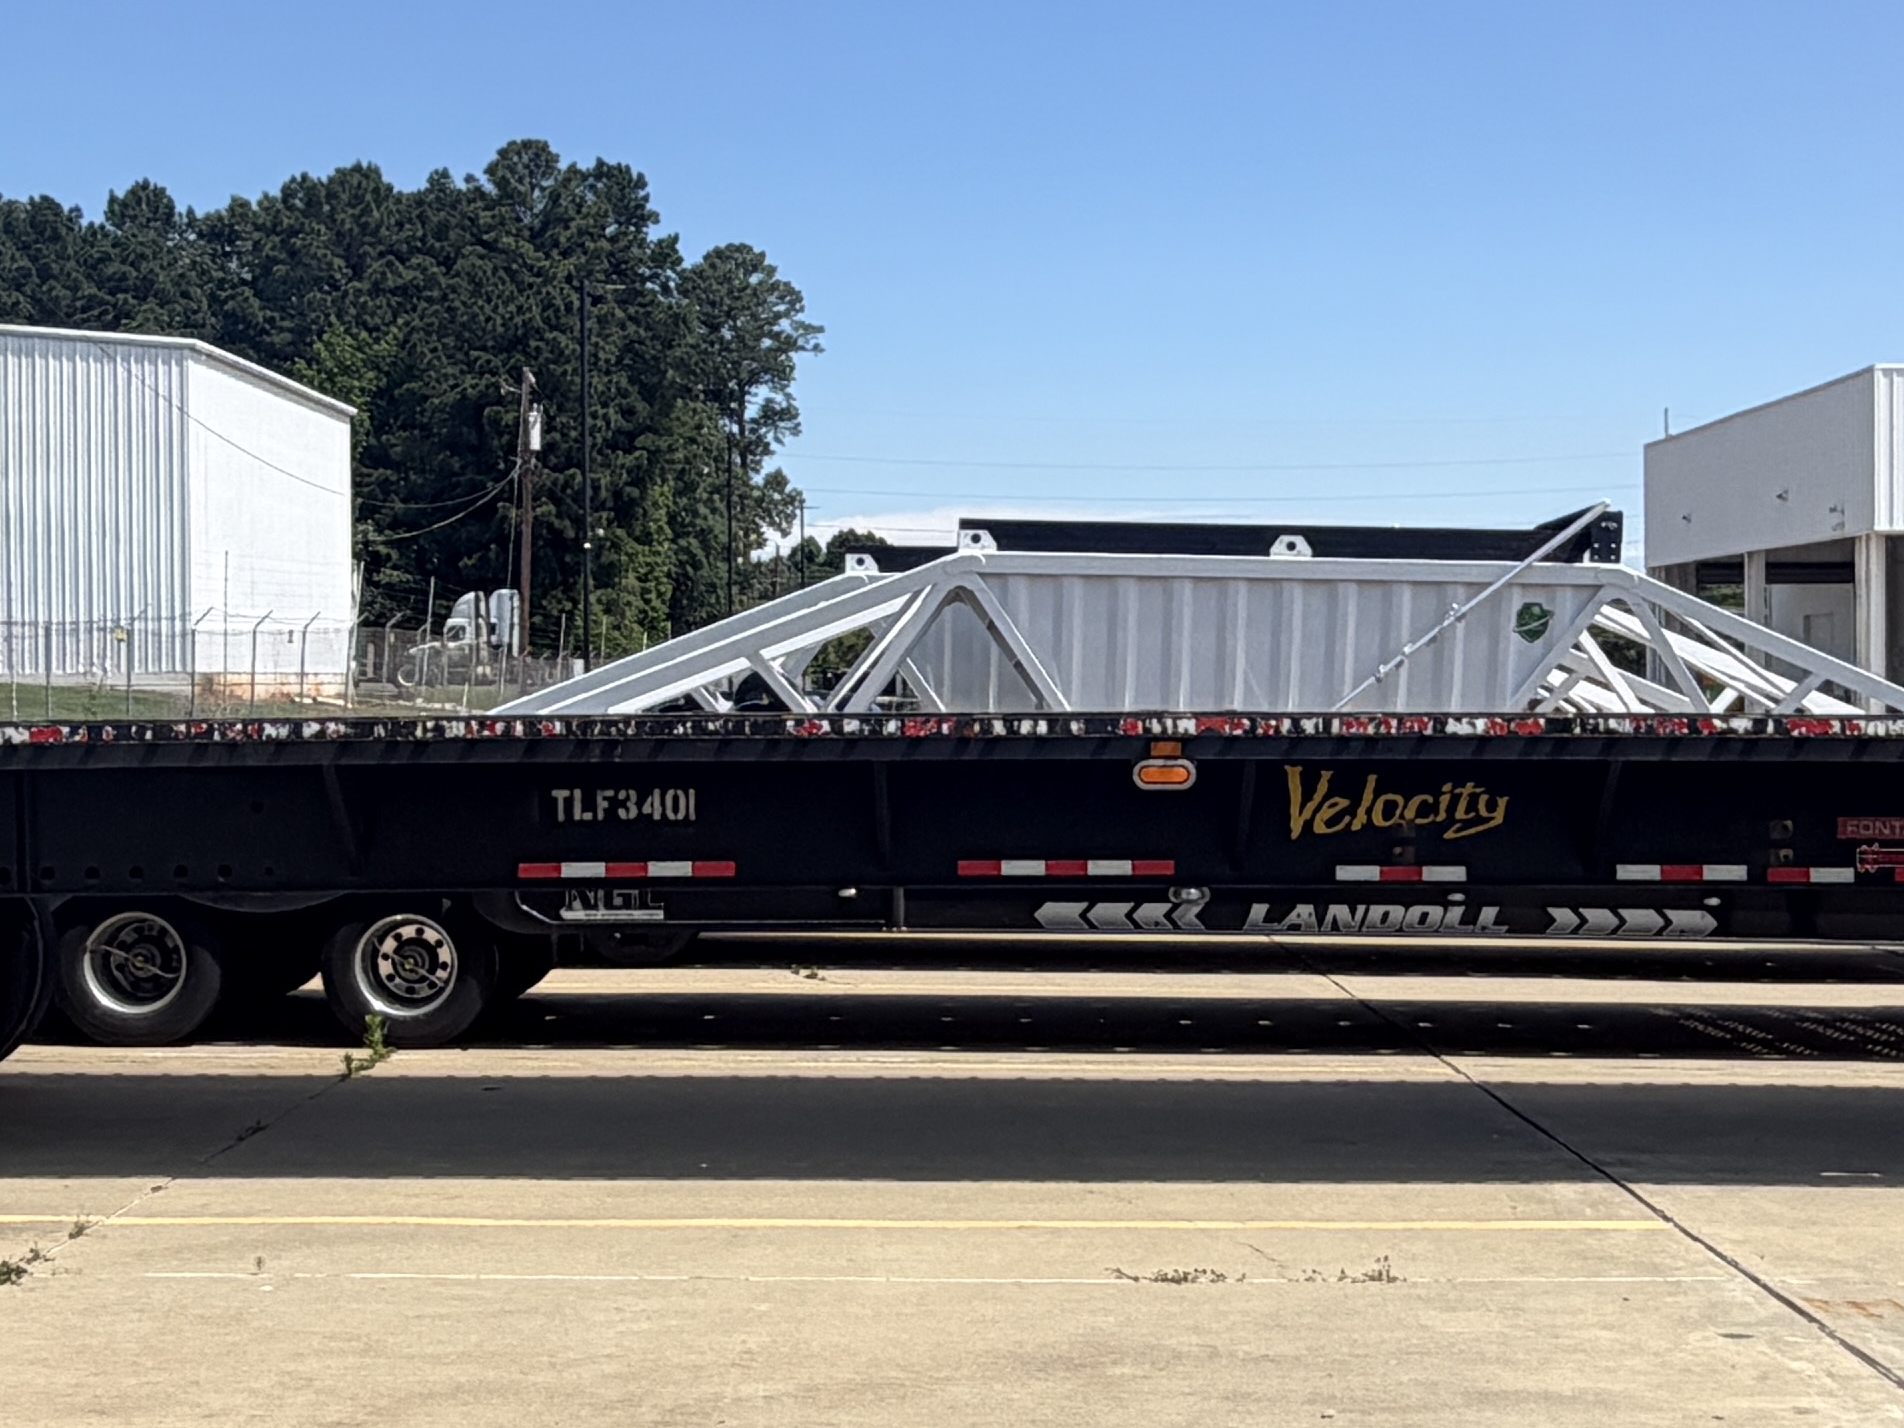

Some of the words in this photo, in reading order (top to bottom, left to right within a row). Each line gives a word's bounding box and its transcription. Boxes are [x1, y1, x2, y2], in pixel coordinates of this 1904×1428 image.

[551, 788, 696, 822] TLF3401
[1284, 764, 1509, 840] Velocity
[1243, 903, 1509, 933] LANDOLL
